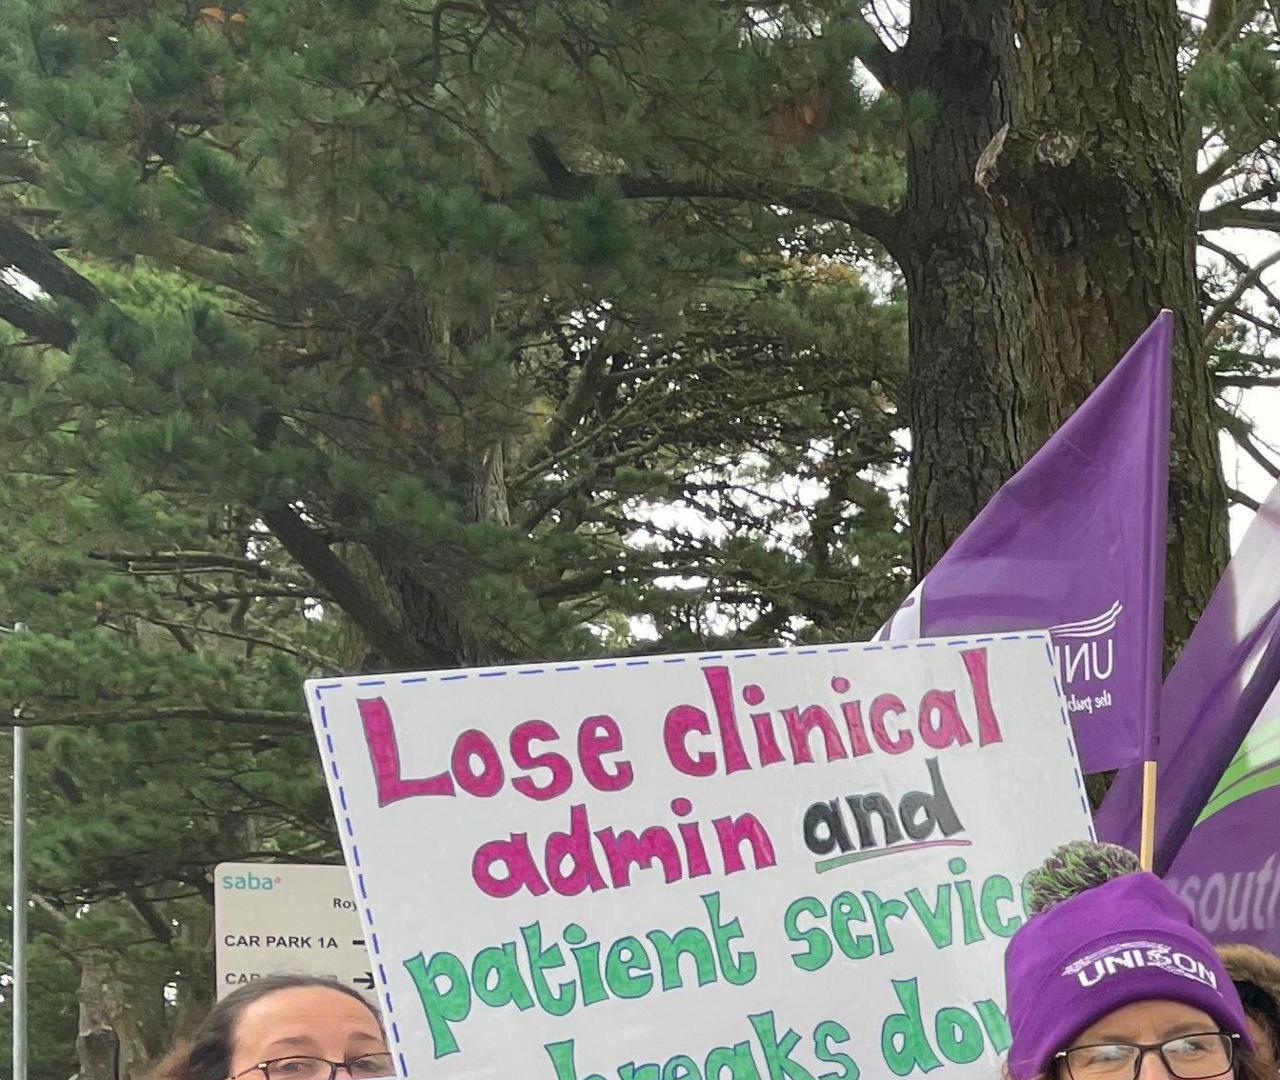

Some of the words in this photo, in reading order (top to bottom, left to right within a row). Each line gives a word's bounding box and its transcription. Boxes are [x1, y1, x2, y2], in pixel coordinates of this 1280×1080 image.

[356, 695, 634, 808] Lose
[664, 647, 1004, 779] clinical
[471, 796, 778, 899] admin
[802, 757, 966, 858] and
[222, 872, 273, 890] saba
[224, 934, 261, 948] CAR
[266, 936, 312, 949] PARK
[318, 937, 339, 949] 1A
[403, 890, 759, 1061] patient
[1077, 947, 1218, 990] UNISON
